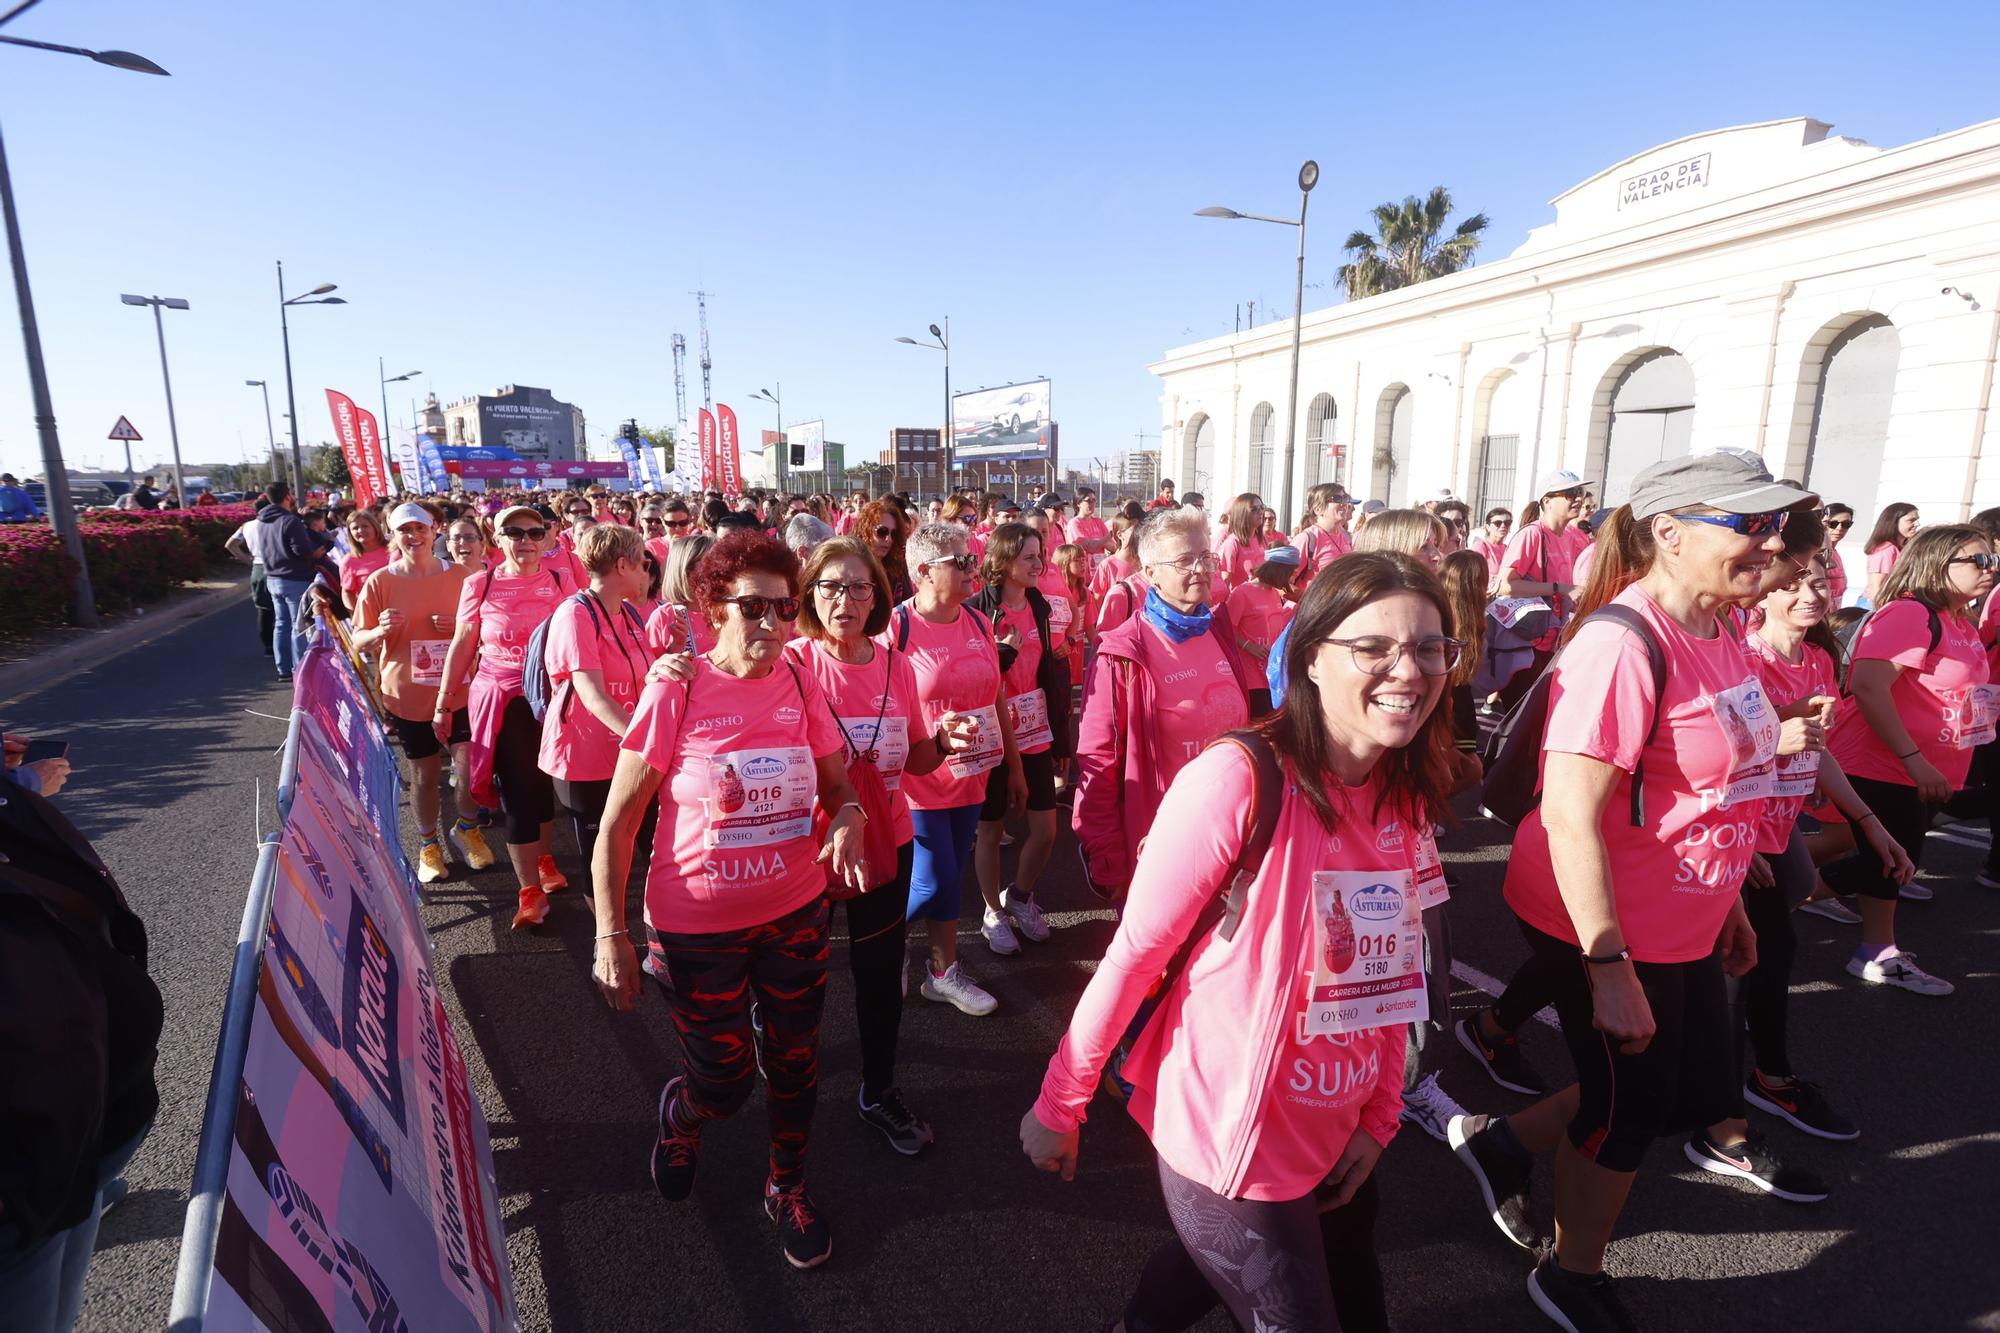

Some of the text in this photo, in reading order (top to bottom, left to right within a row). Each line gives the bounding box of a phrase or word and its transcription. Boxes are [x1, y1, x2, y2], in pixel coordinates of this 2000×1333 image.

[1627, 160, 1702, 191] GRAO DE
[1623, 173, 1702, 204] VALENCIA
[1164, 668, 1198, 684] OYSHO
[608, 682, 630, 696] TU
[929, 698, 952, 714] TU
[695, 715, 743, 729] OYSHO
[748, 786, 782, 802] 016
[1728, 783, 1759, 796] OYSHO
[754, 803, 774, 813] 4121
[770, 813, 789, 821] MUJER
[775, 823, 805, 834] Santander
[718, 832, 752, 842] OYSHO
[703, 851, 786, 881] SUMA
[1359, 934, 1397, 957] 016
[1364, 961, 1389, 976] 5180
[1328, 987, 1361, 998] CARRERA
[1361, 985, 1372, 994] DE
[1371, 984, 1381, 993] LA
[1381, 981, 1400, 991] MUJER
[355, 915, 392, 1102] Norauto
[1384, 999, 1417, 1013] Santander
[1320, 1007, 1359, 1023] OYSHO
[1289, 1048, 1379, 1097] SUMA
[429, 1080, 443, 1105] a
[431, 1103, 475, 1296] Kilómetro
